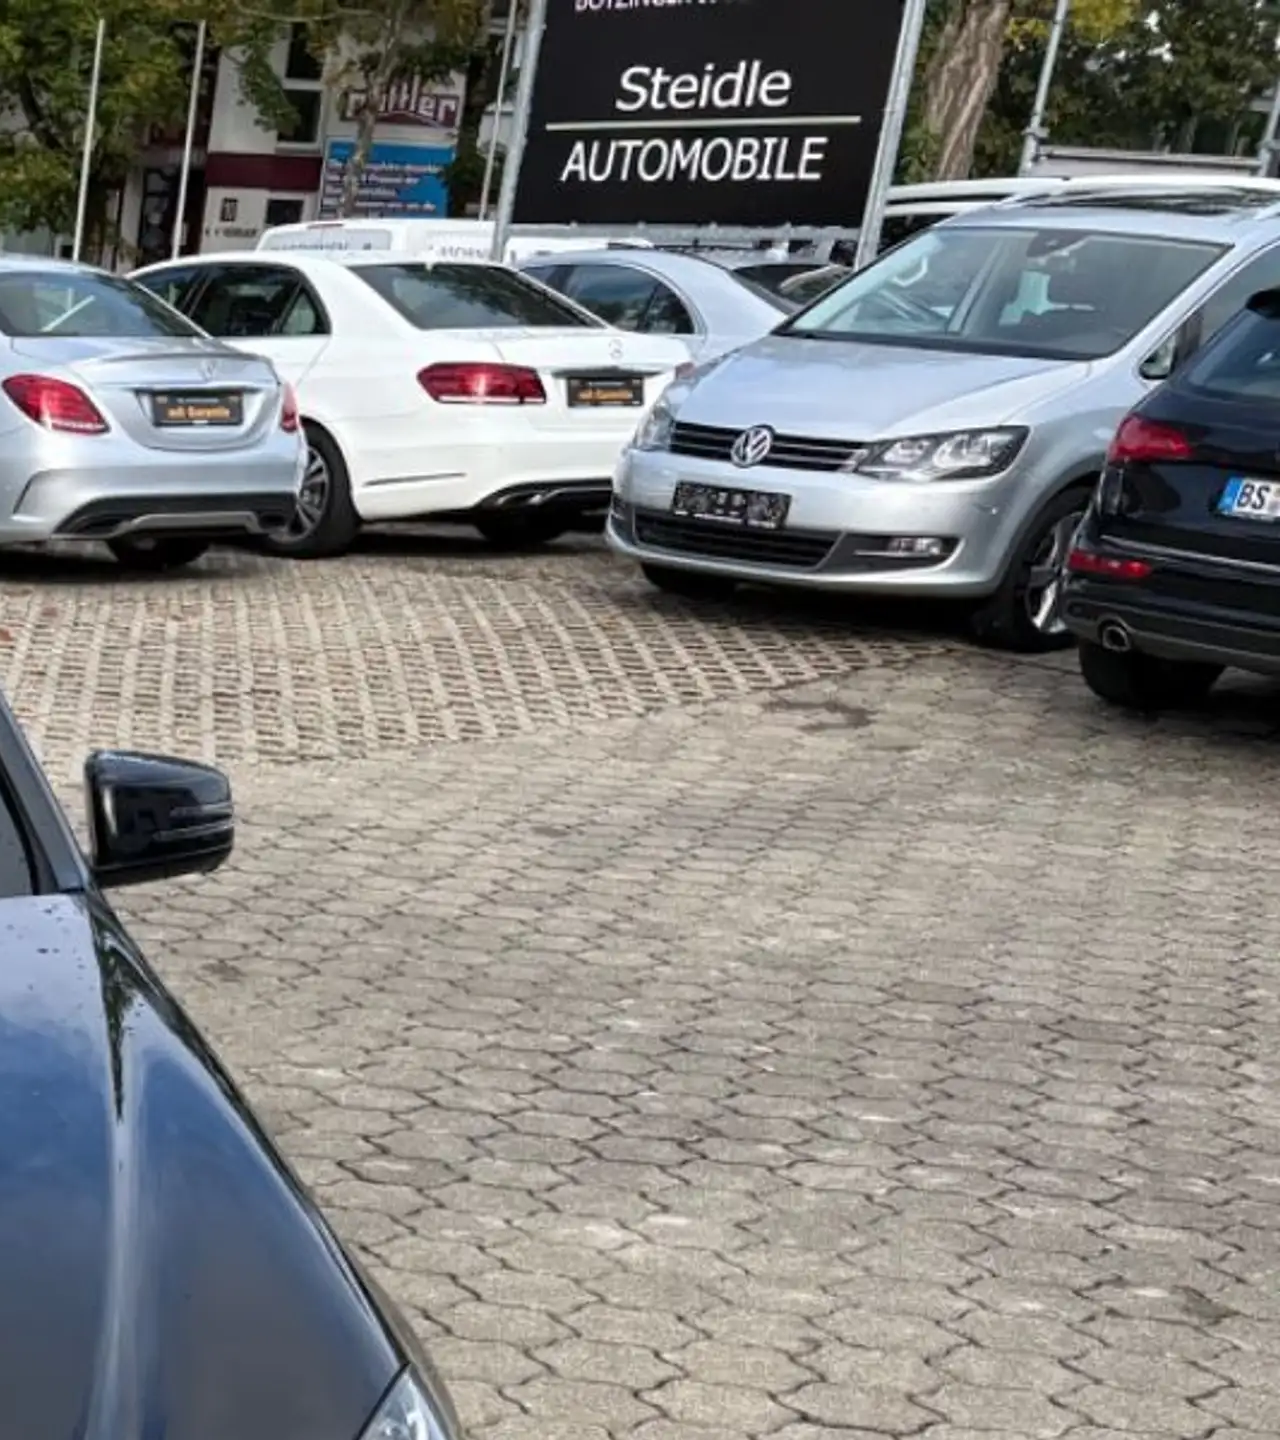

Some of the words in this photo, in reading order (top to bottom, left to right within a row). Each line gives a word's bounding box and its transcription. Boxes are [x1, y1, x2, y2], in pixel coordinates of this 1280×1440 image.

[614, 59, 791, 112] Steidle
[560, 136, 829, 182] AUTOMOBILE
[1237, 484, 1270, 510] BS
